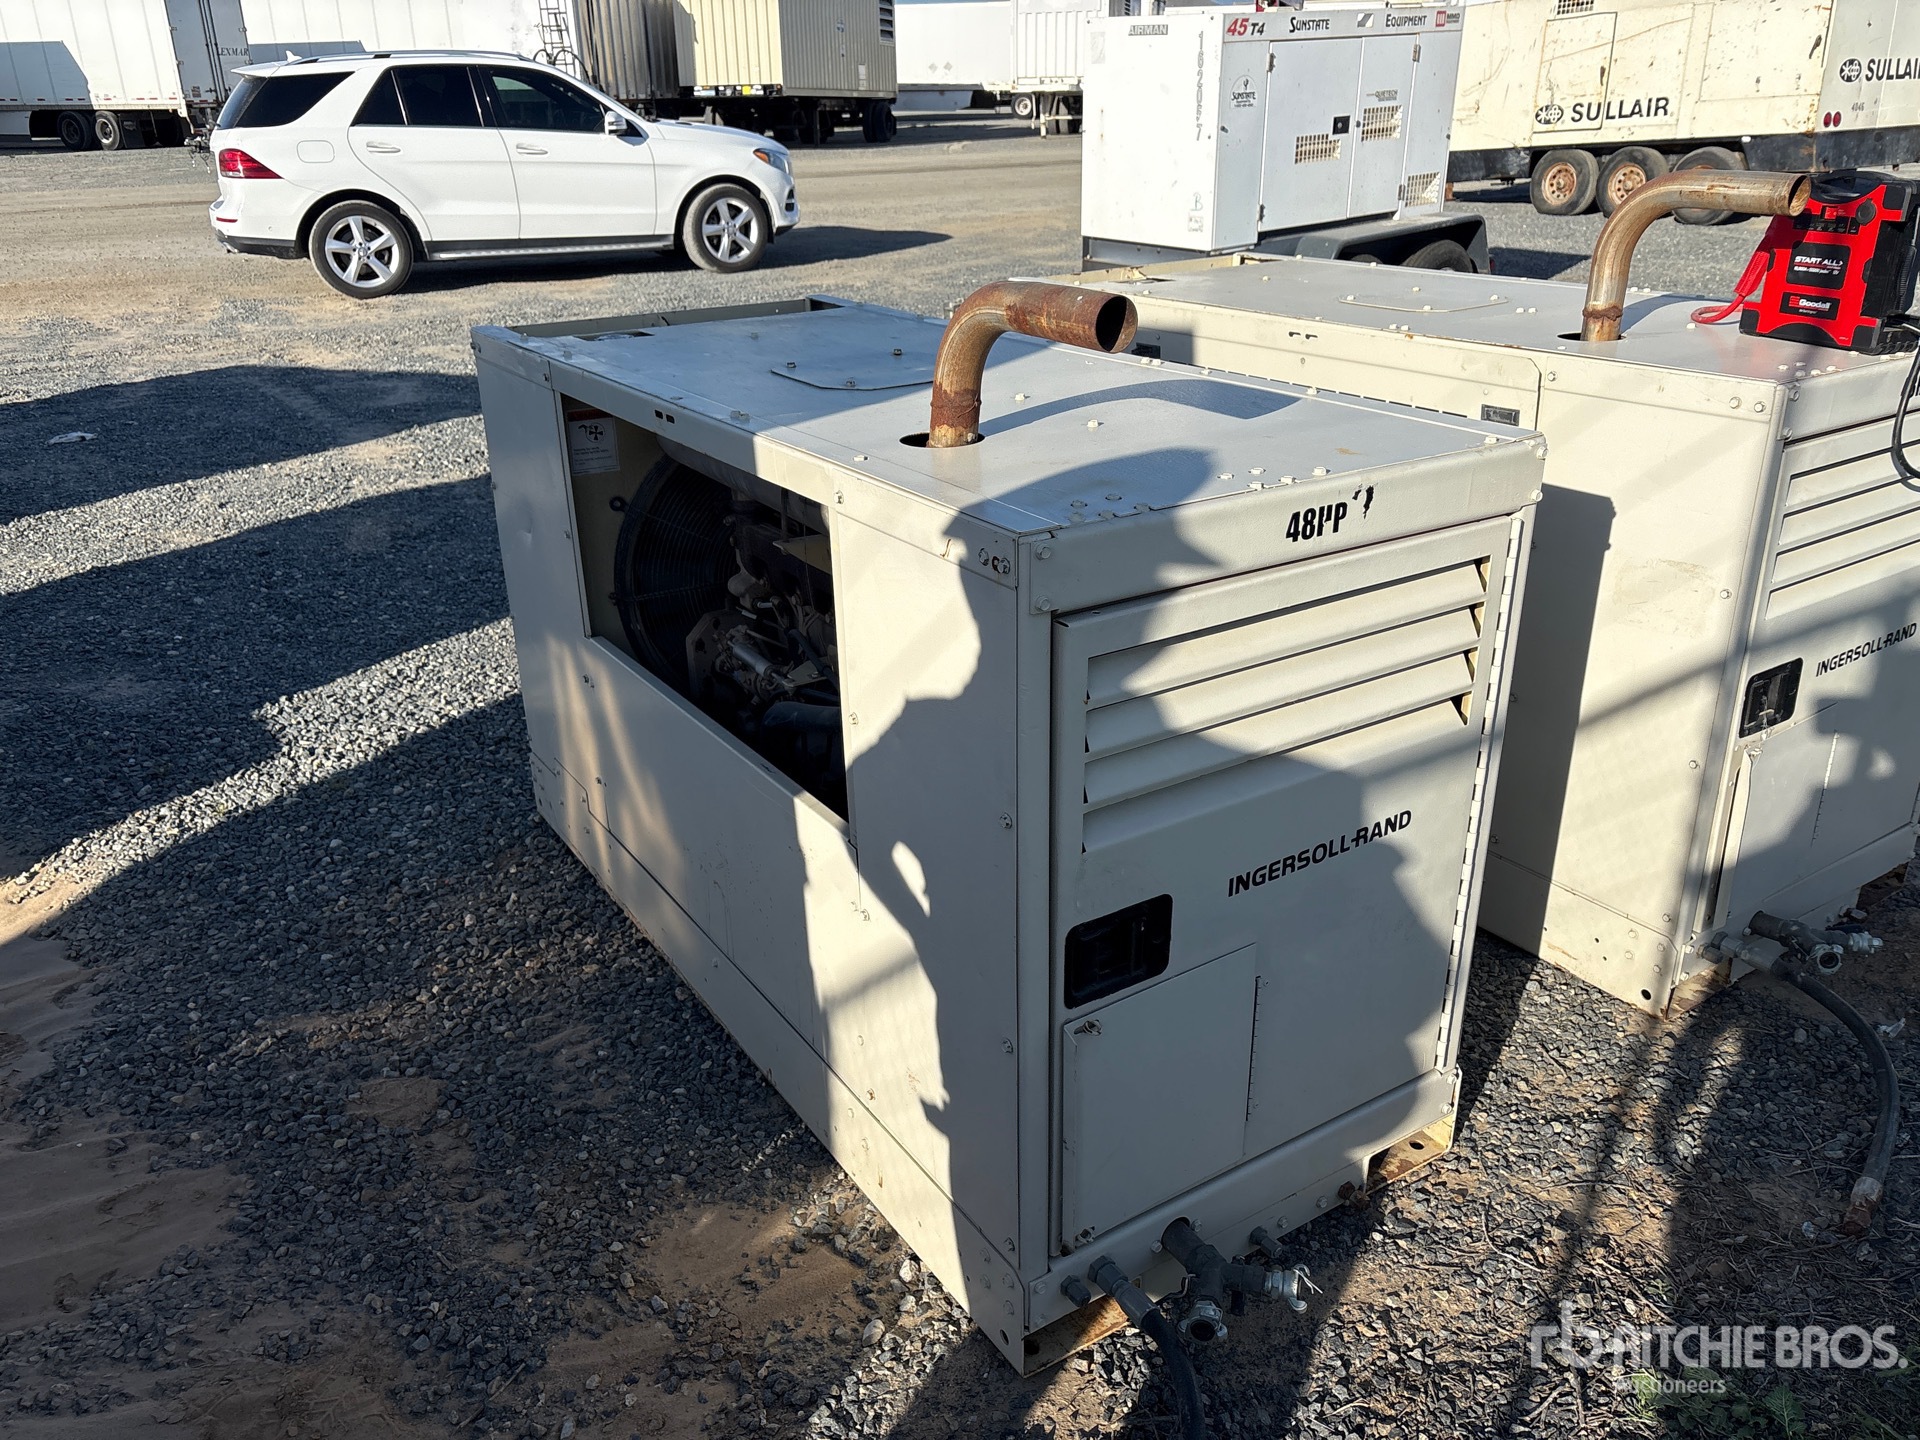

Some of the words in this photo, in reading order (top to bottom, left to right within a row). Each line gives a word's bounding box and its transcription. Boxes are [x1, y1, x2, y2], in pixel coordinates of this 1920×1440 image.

[1128, 24, 1168, 36] AIRMAN
[1226, 17, 1250, 36] 45
[1250, 22, 1266, 36] T4
[1288, 16, 1330, 33] SUNSTATE
[1385, 13, 1428, 28] EQUIPMENT
[1865, 57, 1920, 82] SULLAI
[1570, 96, 1670, 123] SULLAIR
[1794, 255, 1822, 265] START
[1798, 298, 1831, 309] Goodall
[1815, 622, 1917, 677] INGERSOLL-RAND
[1227, 810, 1412, 897] INGERSOLL-RAND
